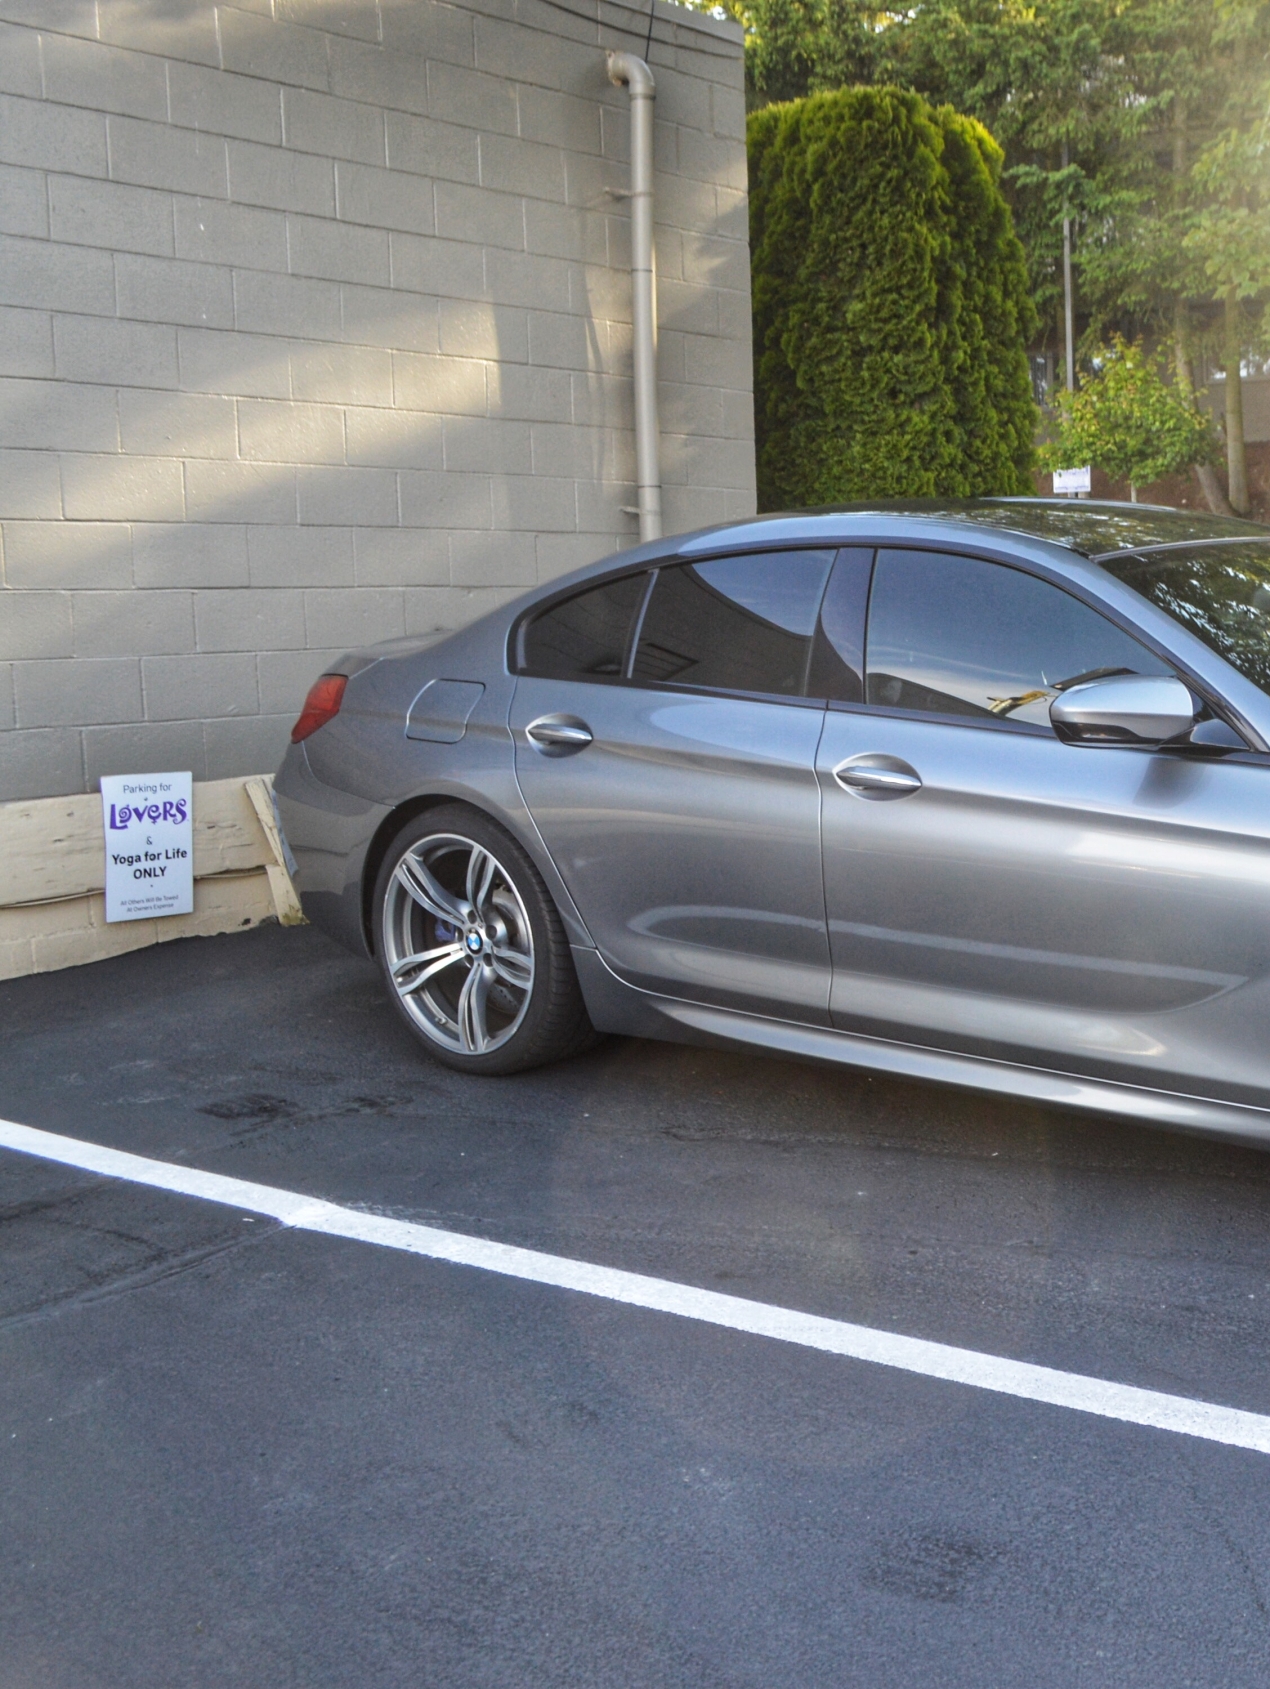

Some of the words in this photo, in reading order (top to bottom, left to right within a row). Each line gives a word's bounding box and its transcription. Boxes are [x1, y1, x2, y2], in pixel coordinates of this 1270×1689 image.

[123, 784, 157, 795] Parking
[159, 783, 172, 792] for
[146, 836, 153, 845] &
[112, 854, 141, 867] Yoga
[144, 850, 162, 862] for
[165, 848, 187, 860] Life
[133, 866, 167, 879] ONLY
